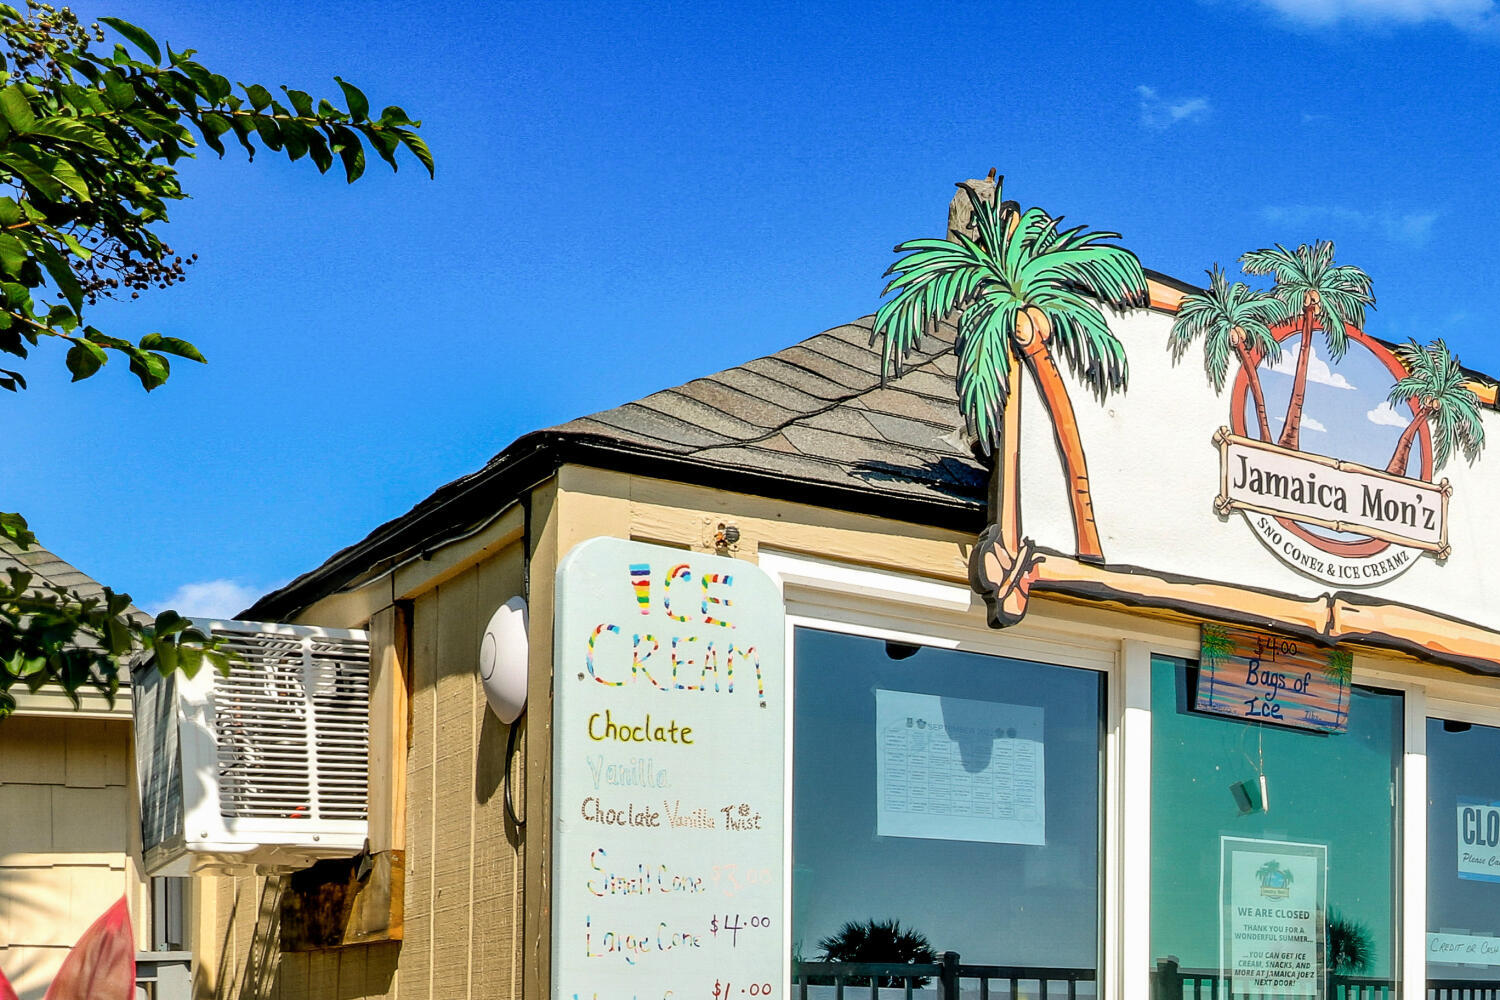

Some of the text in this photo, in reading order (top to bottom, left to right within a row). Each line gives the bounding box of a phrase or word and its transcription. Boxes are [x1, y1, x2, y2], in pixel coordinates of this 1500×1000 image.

[1233, 454, 1436, 531] Jamaica Mon'z
[1257, 516, 1410, 579] SNO CONEZ & ICE CREAMZ
[629, 563, 736, 629] ICE
[586, 623, 764, 699] CREAM
[1253, 635, 1298, 663] $4.00
[1246, 659, 1312, 701] Bags of
[1244, 696, 1284, 721] Ice
[588, 709, 695, 745] Choclate
[586, 754, 670, 789] Vanilla
[581, 796, 763, 831] Choclate Vanilla Twist
[587, 848, 651, 897] Small
[658, 864, 704, 894] Cone
[1463, 852, 1486, 866] Please
[1238, 907, 1310, 919] WE ARE CLOSED
[586, 914, 771, 965] Large Cone $4.00
[1235, 933, 1278, 941] WONDERFUL
[1281, 952, 1294, 960] GET
[1234, 969, 1255, 977] MORE
[1266, 970, 1297, 979] JAMAICA
[1274, 979, 1296, 987] DOOR!
